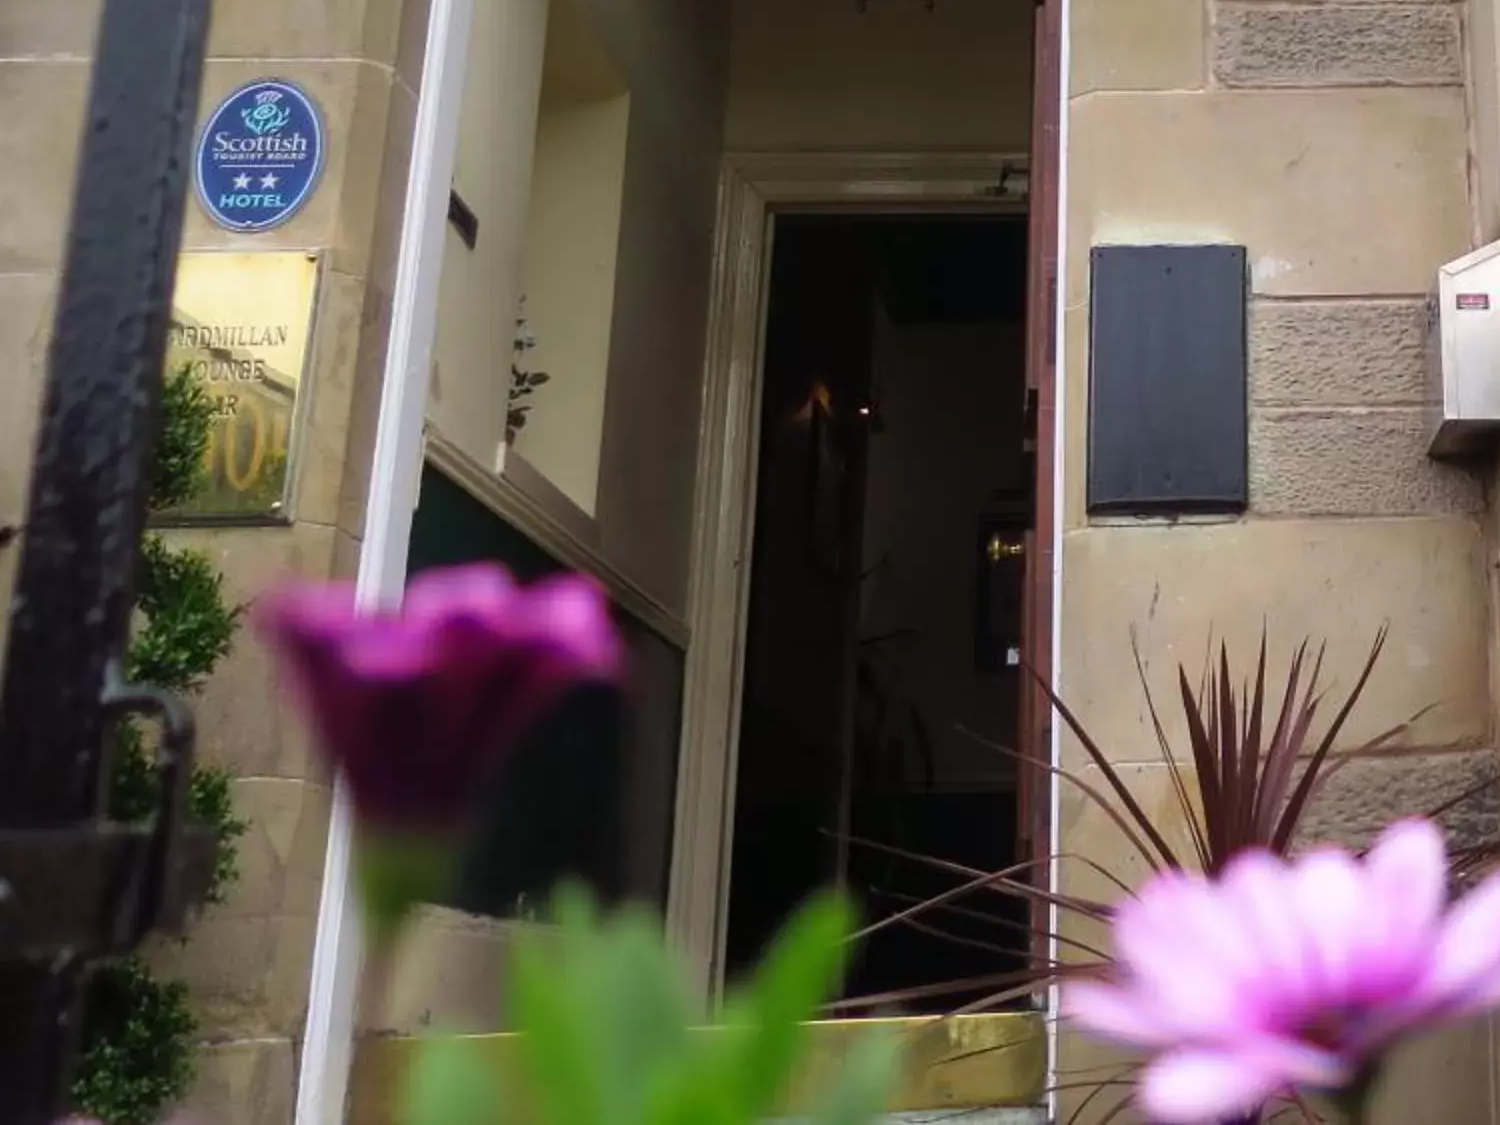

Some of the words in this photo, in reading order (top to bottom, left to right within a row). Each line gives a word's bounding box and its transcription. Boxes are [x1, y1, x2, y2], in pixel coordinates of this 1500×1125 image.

[212, 131, 307, 152] Scottish
[219, 193, 287, 209] HOTEL
[190, 359, 265, 382] OUNGE
